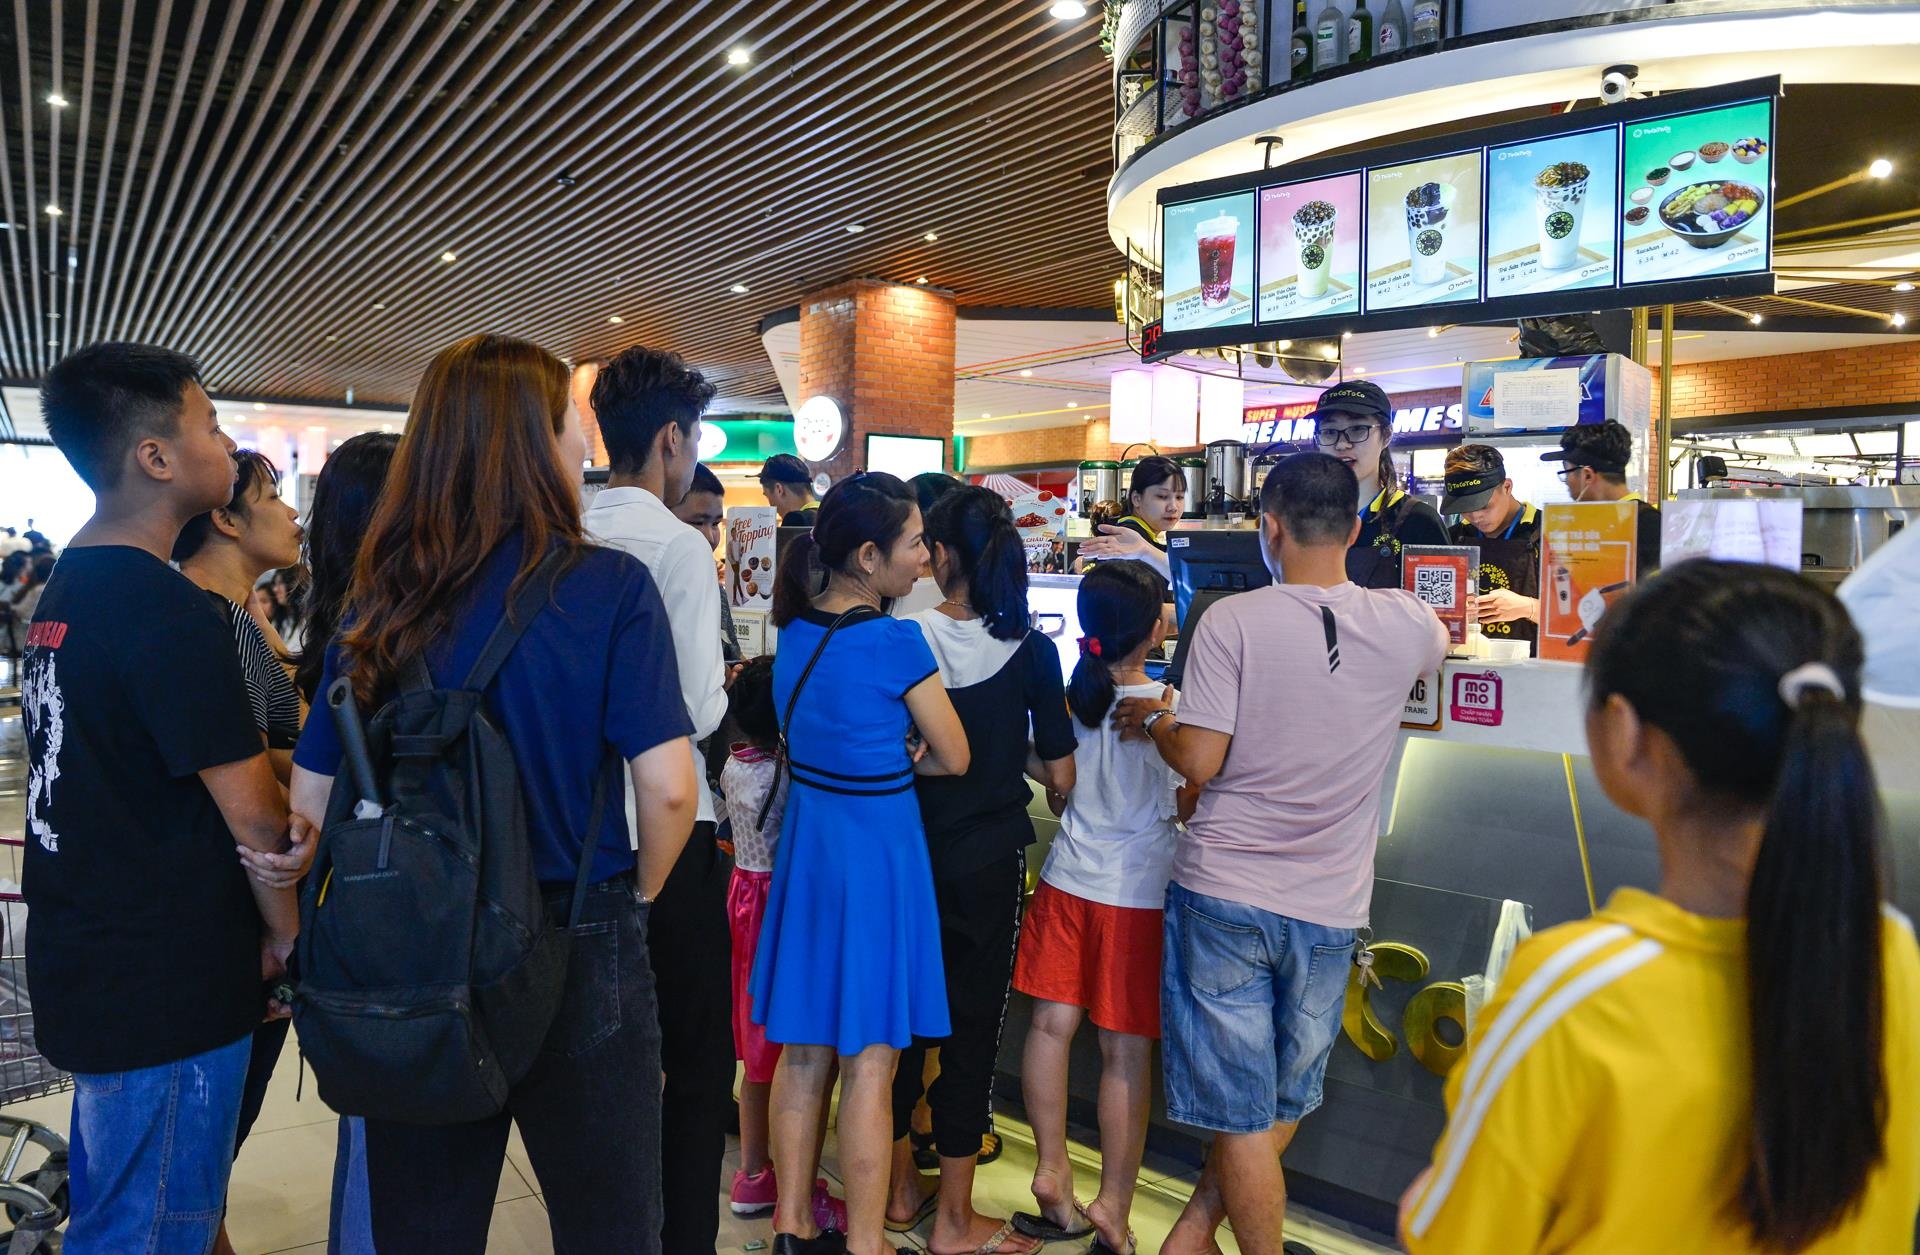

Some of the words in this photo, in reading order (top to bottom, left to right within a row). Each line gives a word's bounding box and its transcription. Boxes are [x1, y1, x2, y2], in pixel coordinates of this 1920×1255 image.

[1245, 411, 1278, 422] SUPER
[733, 517, 752, 530] Free
[738, 524, 774, 553] Topping
